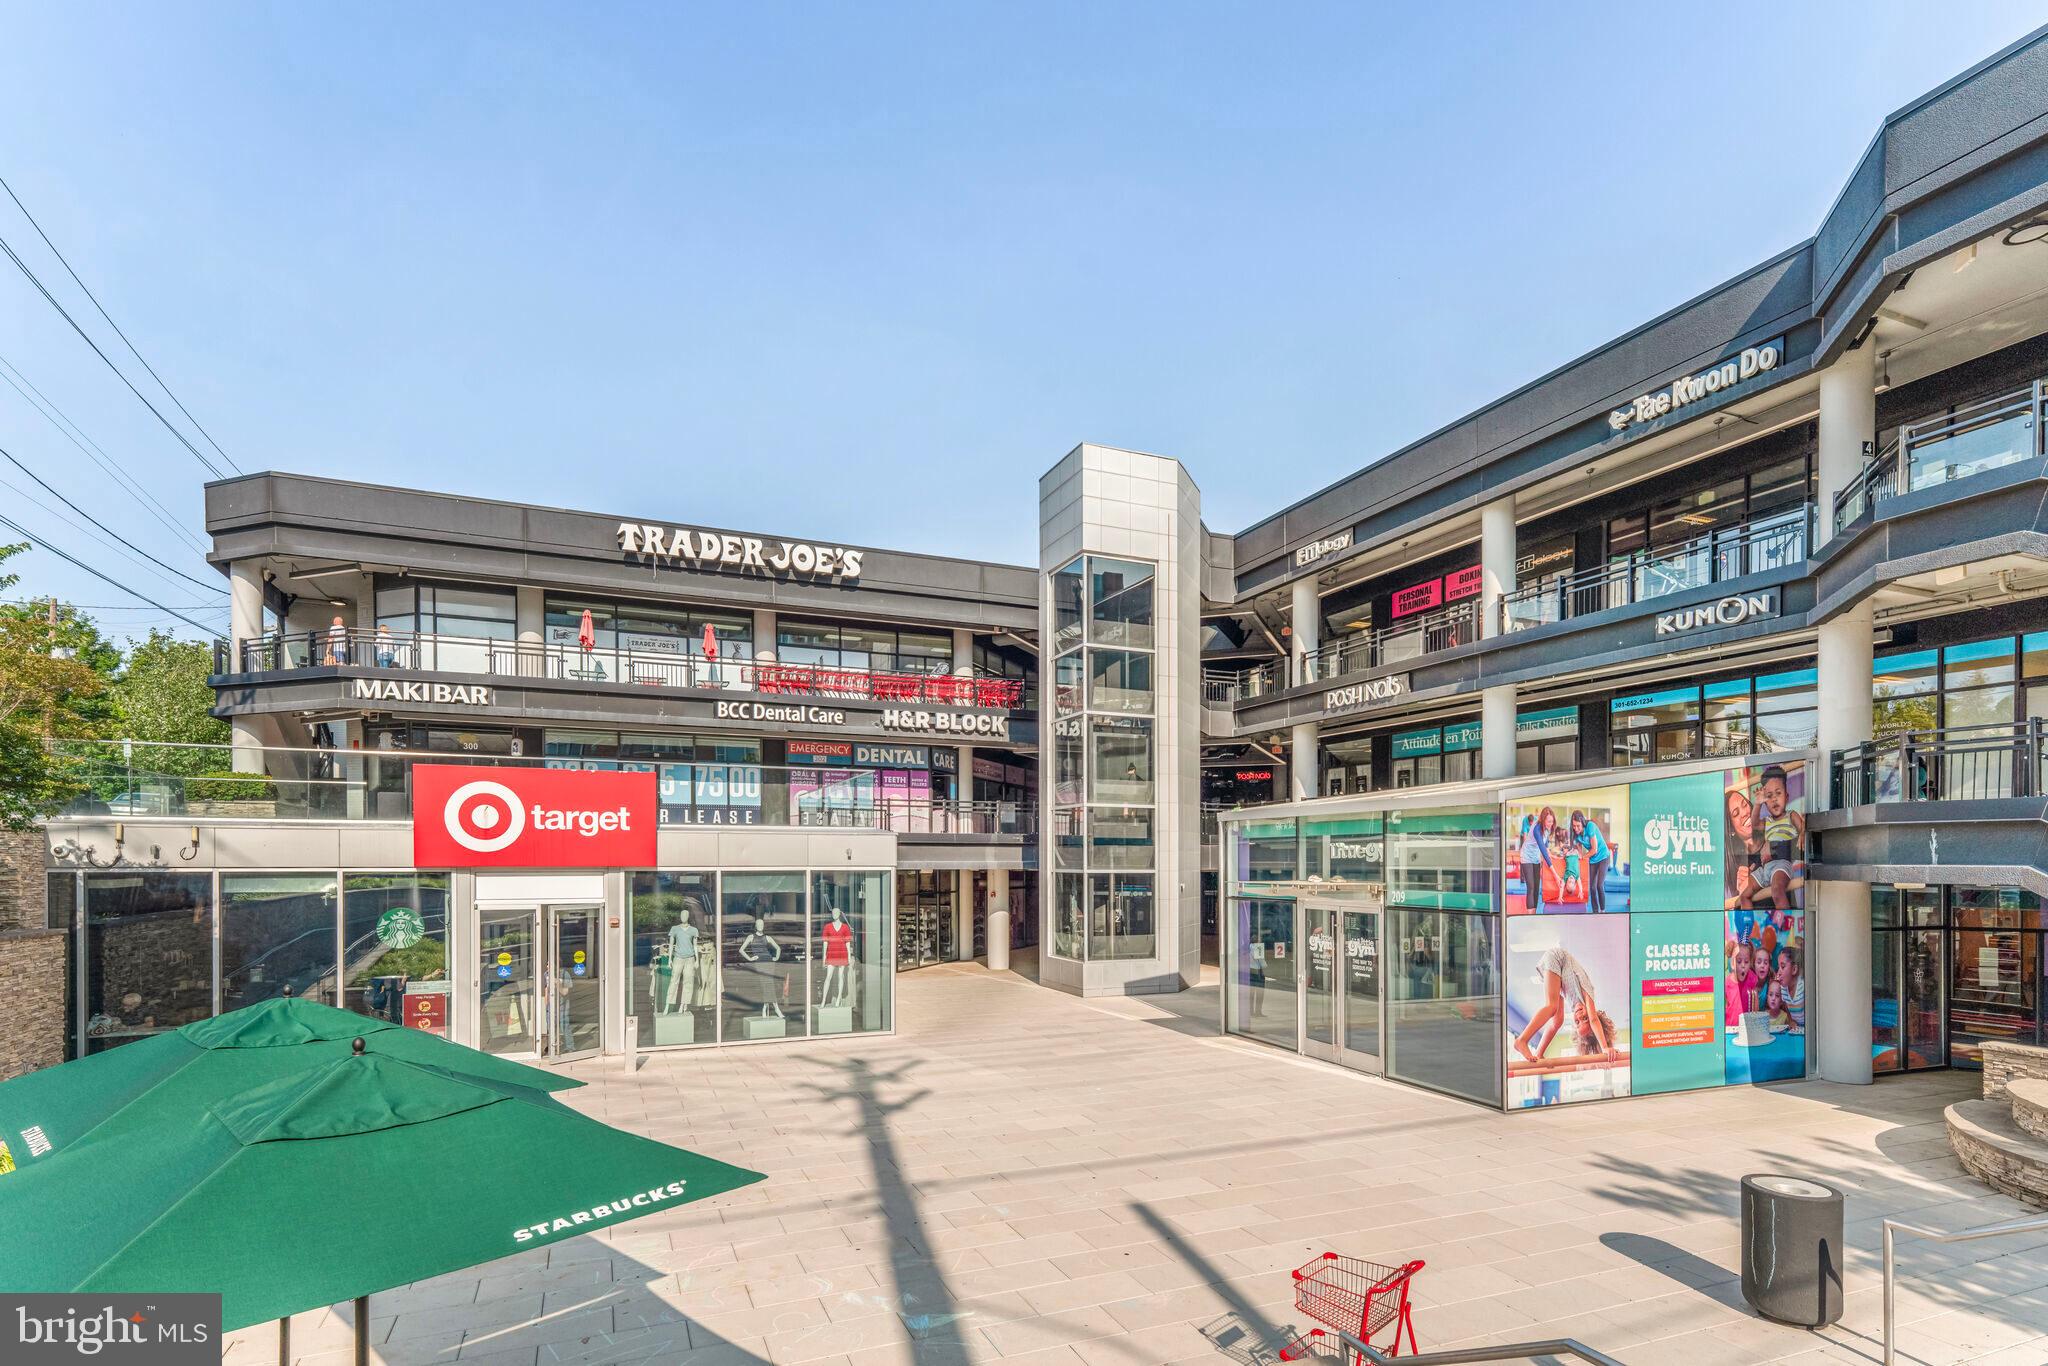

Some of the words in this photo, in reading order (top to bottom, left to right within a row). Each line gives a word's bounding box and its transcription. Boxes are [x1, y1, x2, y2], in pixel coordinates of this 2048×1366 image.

[1673, 363, 1738, 407] Kwon
[1740, 346, 1778, 379] Do
[1865, 441, 1872, 454] 4
[617, 522, 768, 566] TRADER
[769, 541, 864, 578] JOE'S
[1398, 584, 1433, 604] PERSONAL
[1399, 596, 1431, 613] TRAINING
[1656, 594, 1770, 635] KUMON
[630, 640, 657, 648] TRADER
[356, 678, 430, 703] MAKI
[433, 683, 490, 705] BAR
[1327, 685, 1363, 709] POSH
[1614, 697, 1654, 708] 301-652-1234
[717, 702, 750, 719] BCC
[753, 705, 805, 723] Dental
[808, 707, 845, 725] Care
[884, 709, 931, 730] H&R
[935, 711, 1007, 733] BLOCK
[1543, 715, 1576, 728] Studio
[1880, 720, 1912, 730] WORLD'S
[790, 743, 851, 755] EMERGENCY
[1401, 734, 1441, 751] Attitude
[1445, 733, 1459, 744] en
[857, 747, 925, 765] DENTAL
[933, 752, 955, 769] CARE
[1661, 751, 1690, 761] KUMON
[883, 776, 907, 784] TEETH
[531, 805, 631, 837] target
[684, 809, 753, 824] LEASE
[1670, 812, 1709, 831] Little
[1644, 819, 1712, 859] gym
[1644, 861, 1687, 875] Serious
[1690, 861, 1715, 875] Fun.
[1391, 891, 1406, 903] 209
[1645, 944, 1700, 958] CLASSES
[1702, 943, 1711, 956] &
[1645, 957, 1711, 972] PROGRAMS
